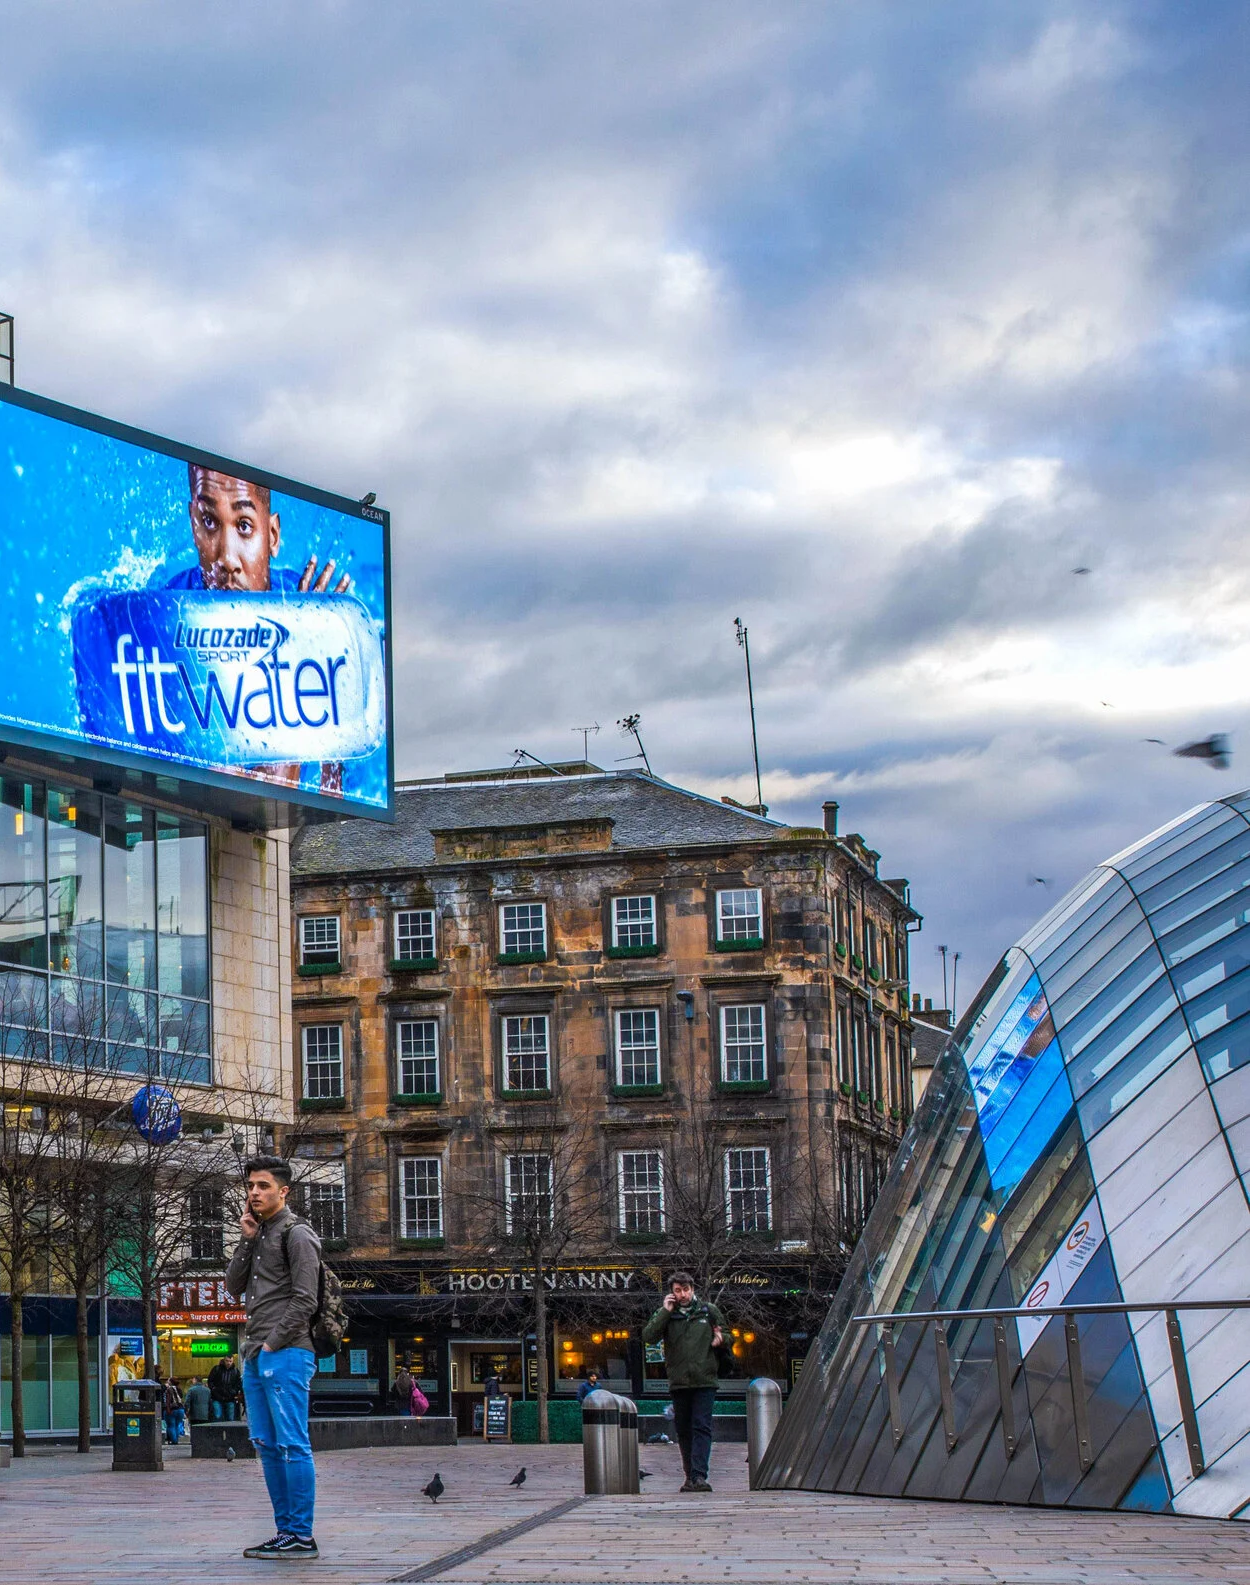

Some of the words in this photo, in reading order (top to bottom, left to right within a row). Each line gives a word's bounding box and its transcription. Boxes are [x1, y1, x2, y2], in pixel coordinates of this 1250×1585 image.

[361, 507, 384, 521] OCEAN
[174, 620, 271, 649] Lucozade
[197, 650, 252, 663] SPORT
[449, 1272, 635, 1291] HOOTENANNY
[156, 1313, 183, 1321] Kebabs
[190, 1313, 219, 1322] Burgers
[224, 1313, 248, 1321] Currie
[191, 1343, 229, 1353] BURGER
